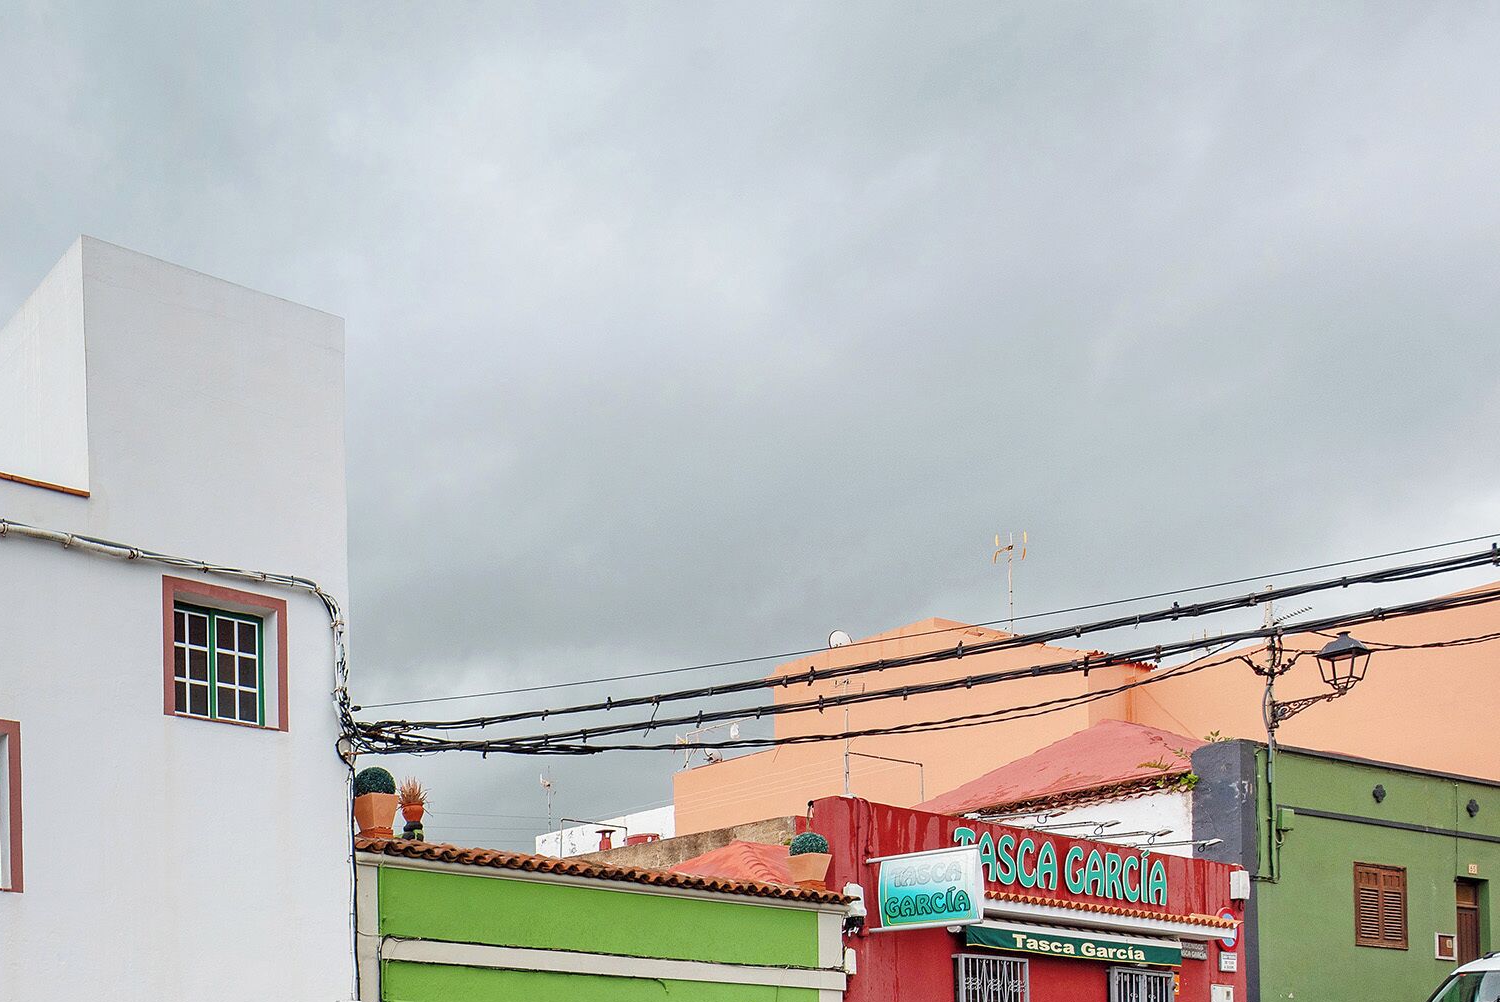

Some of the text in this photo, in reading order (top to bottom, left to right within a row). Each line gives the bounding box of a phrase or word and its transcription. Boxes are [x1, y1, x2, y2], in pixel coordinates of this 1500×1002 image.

[890, 861, 962, 887] TASCA
[1064, 850, 1168, 906] GARCÍA
[885, 886, 971, 918] GARCÍA
[1012, 933, 1146, 961] Tasca García
